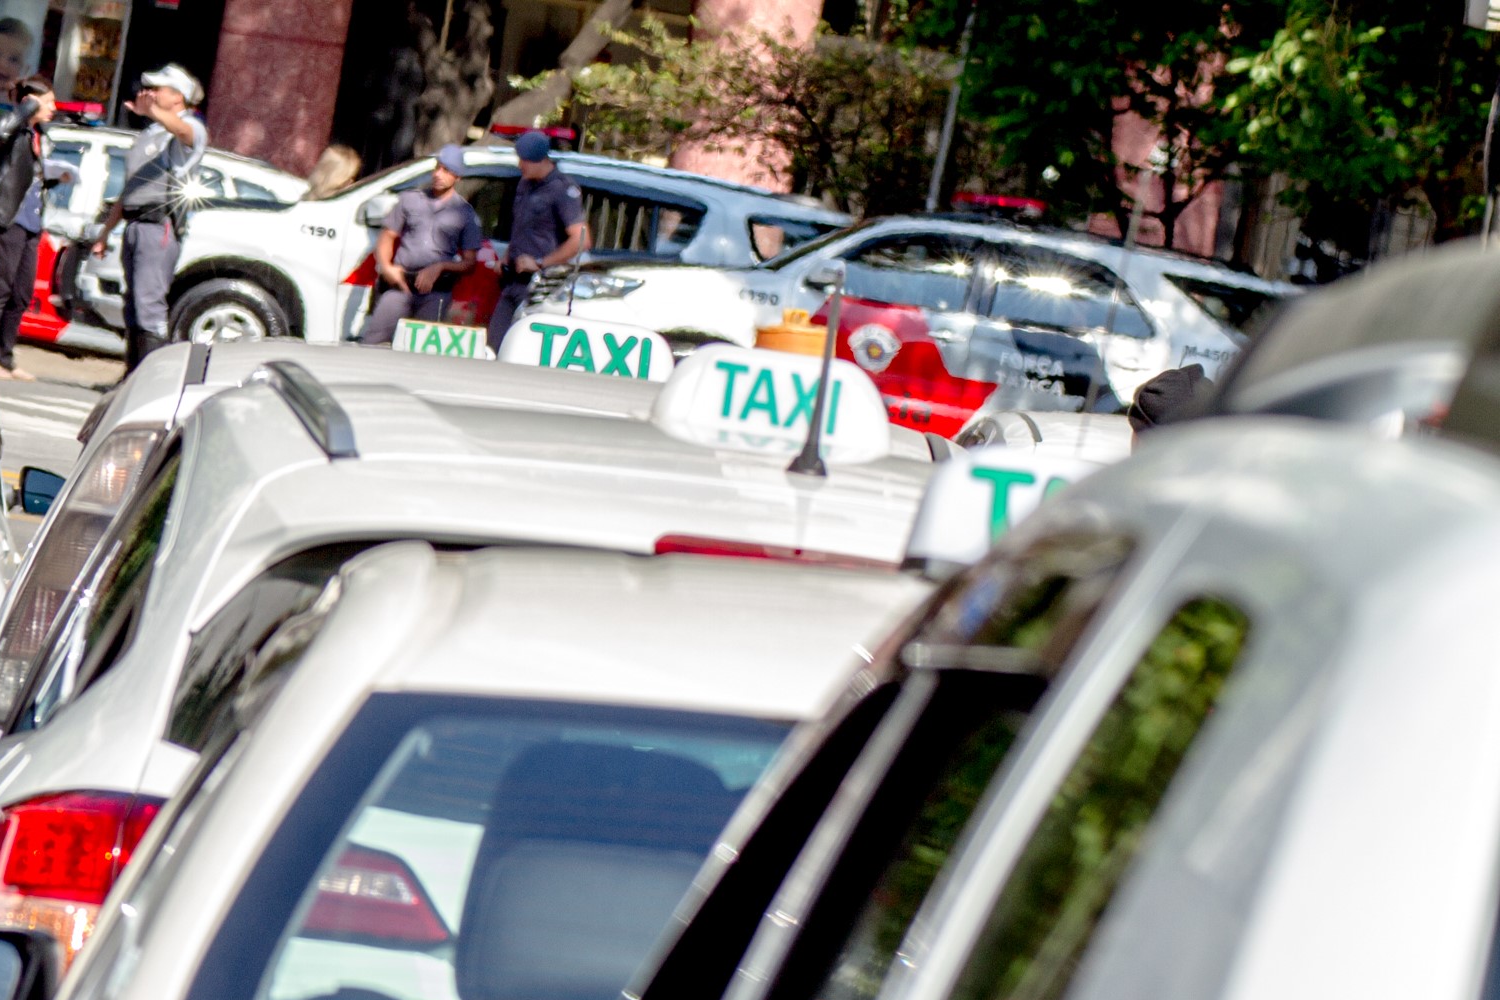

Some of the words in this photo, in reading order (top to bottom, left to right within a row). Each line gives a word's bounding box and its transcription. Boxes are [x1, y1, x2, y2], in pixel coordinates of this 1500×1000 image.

[308, 225, 337, 240] 190
[405, 322, 478, 357] TAXI
[530, 322, 653, 381] TAXI
[715, 360, 842, 436] TAXI
